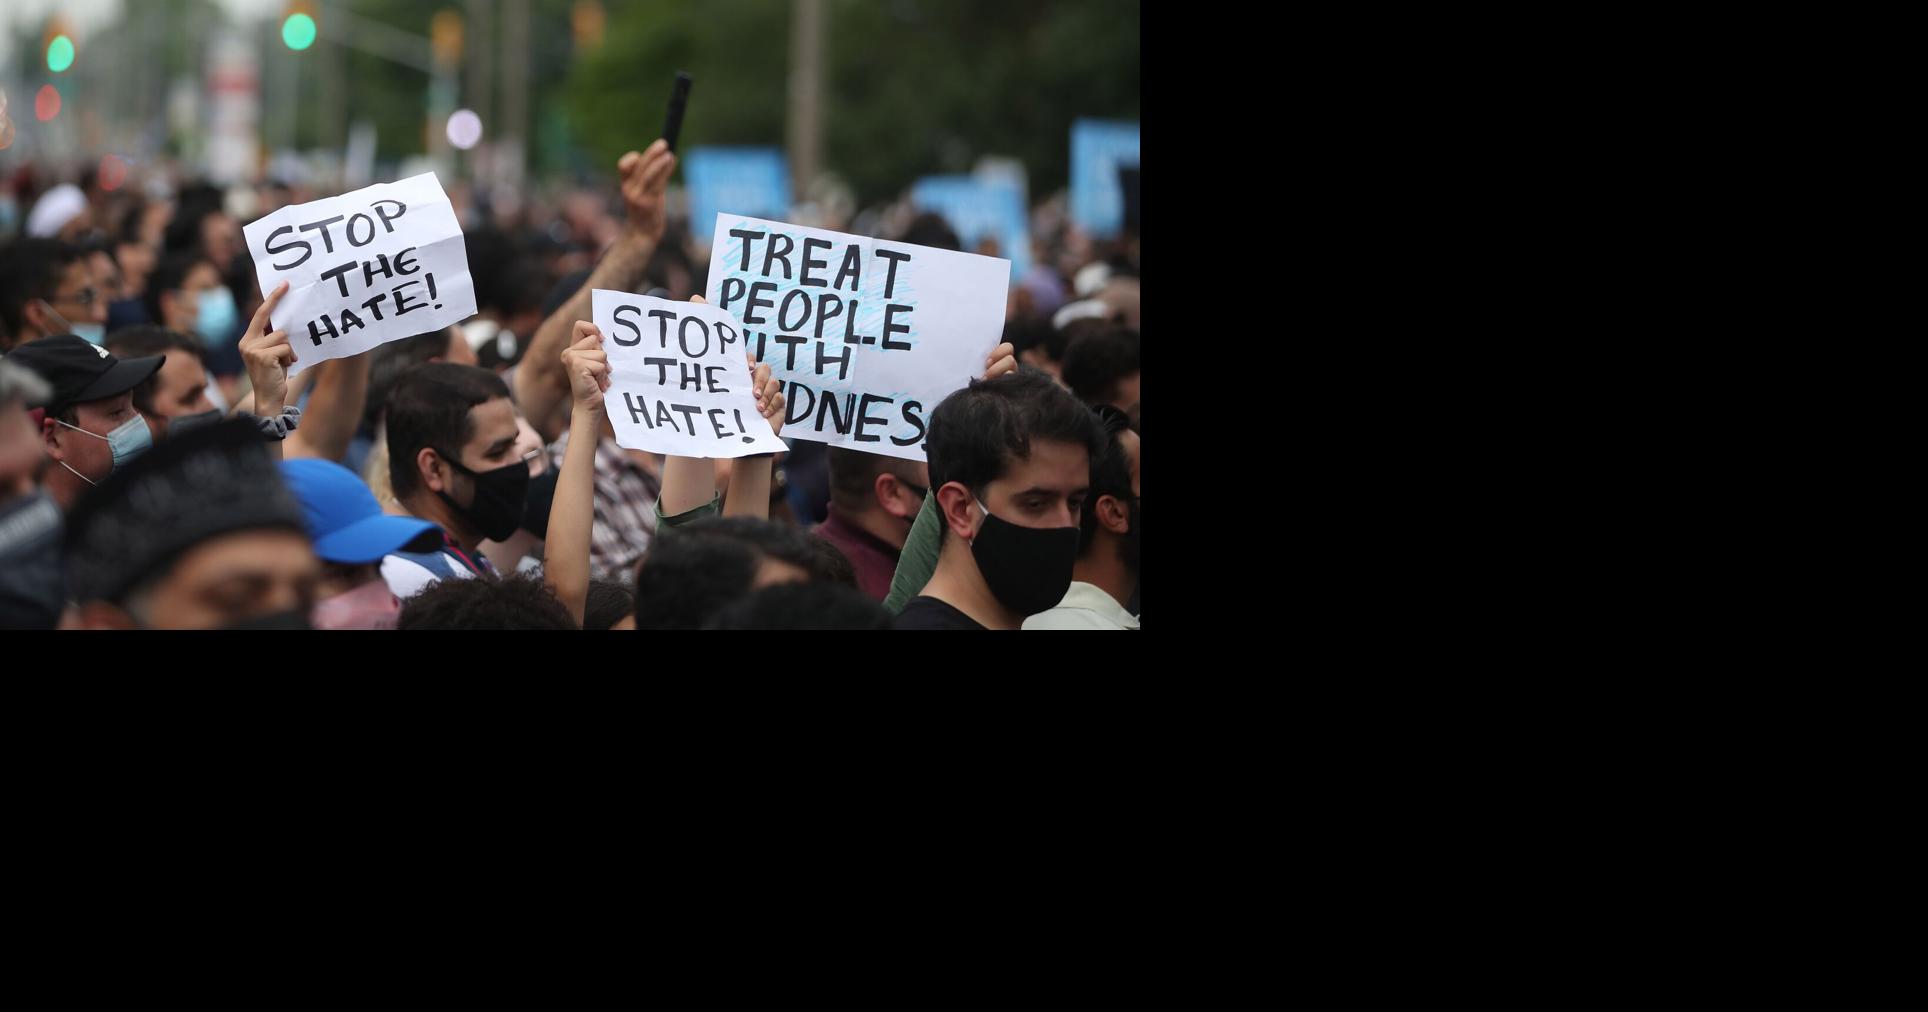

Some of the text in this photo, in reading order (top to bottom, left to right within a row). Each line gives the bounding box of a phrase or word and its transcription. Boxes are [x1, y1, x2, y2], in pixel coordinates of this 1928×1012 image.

[265, 199, 407, 271] STOP
[729, 228, 911, 299] TREAT
[320, 246, 421, 298] THE
[307, 272, 443, 347] HATE!
[612, 304, 738, 359] STOP
[719, 277, 914, 351] PEOPLE
[643, 356, 730, 393] THE
[742, 328, 852, 380] ITH
[622, 392, 756, 444] HATE!
[778, 379, 927, 451] DNES
